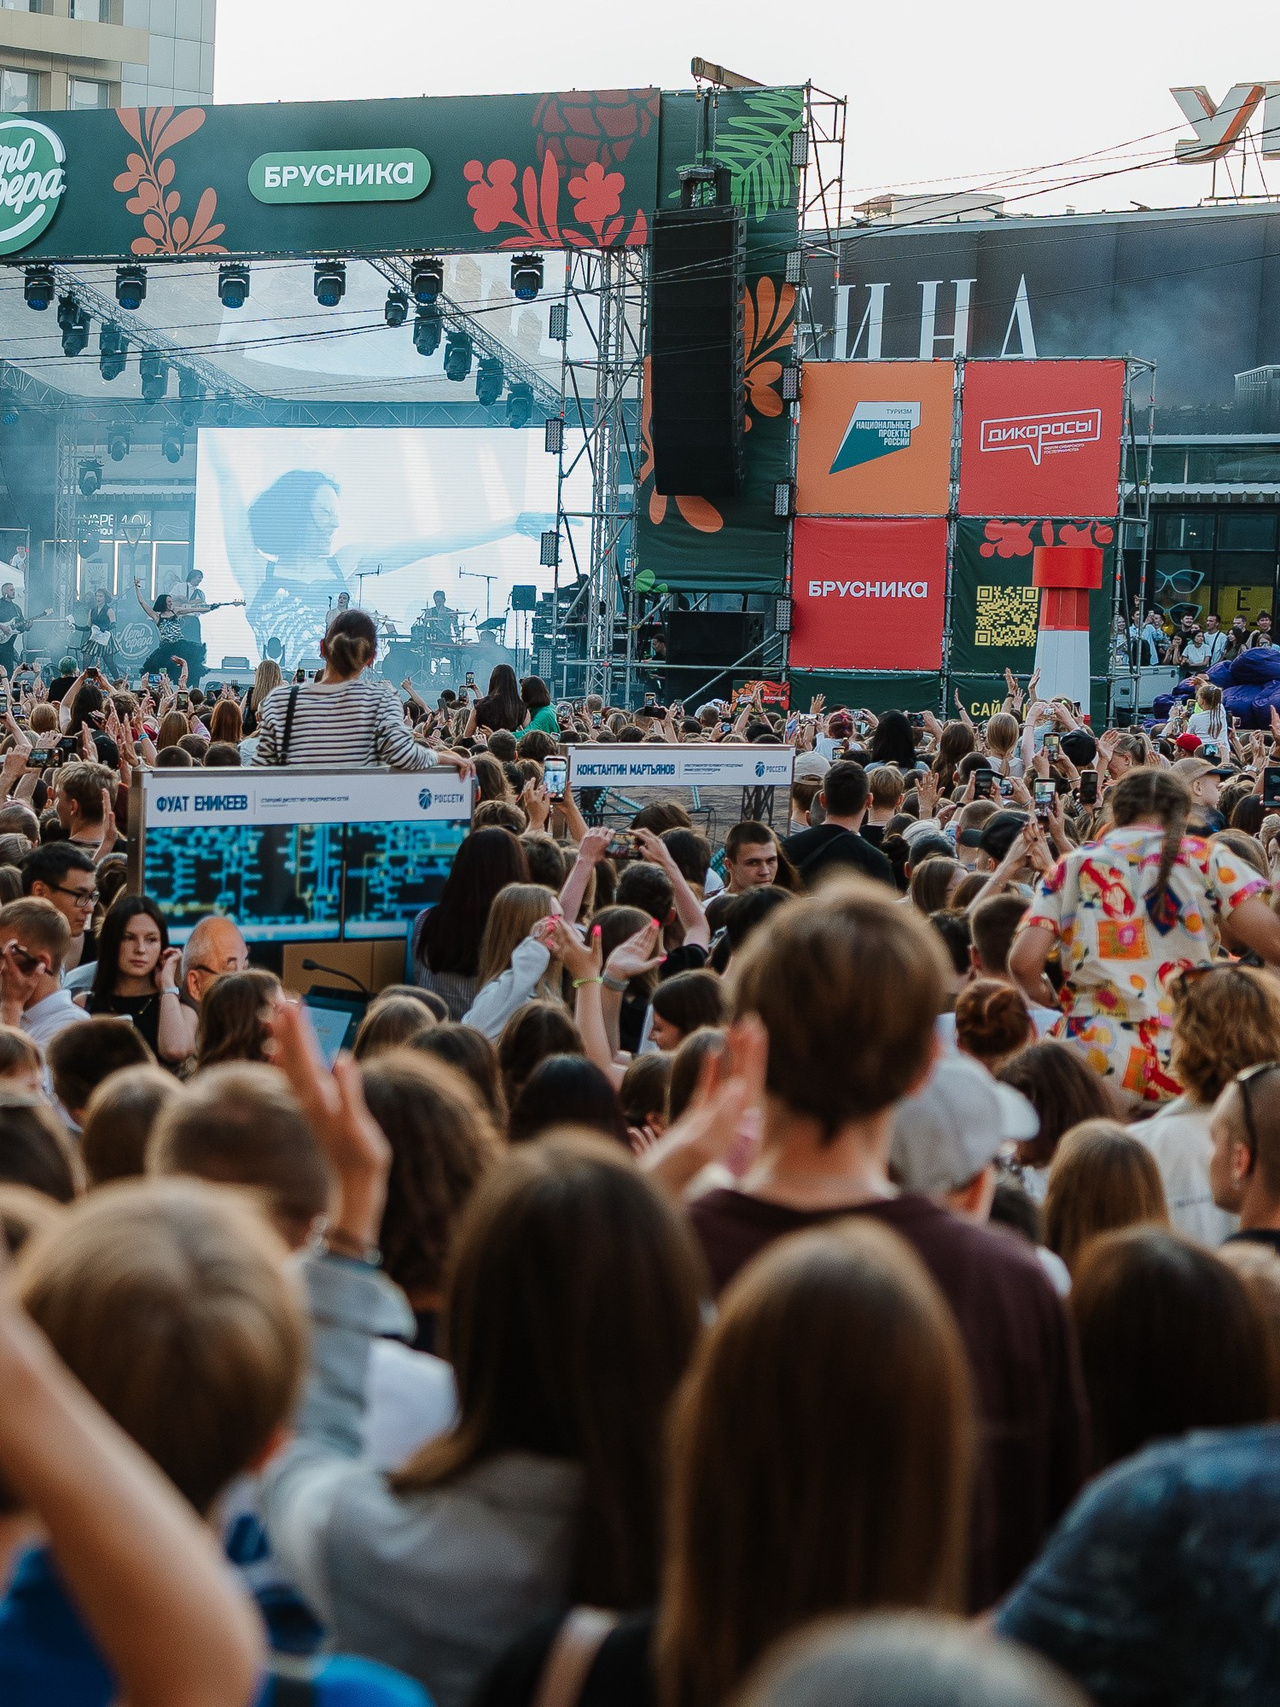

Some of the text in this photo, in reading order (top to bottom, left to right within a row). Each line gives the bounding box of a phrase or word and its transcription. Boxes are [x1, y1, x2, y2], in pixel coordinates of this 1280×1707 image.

[1168, 81, 1280, 165] У
[856, 420, 911, 431] НАЦИОНАЛЬНЫЕ
[987, 419, 1093, 442] ДИКОРОСЫ
[878, 429, 911, 438] ПРОЕКТЫ
[883, 437, 910, 446] РОССИИ
[576, 763, 676, 776] КОНСТАНТИН МАРТЬЯНОВ
[766, 765, 788, 773] РОССЕТИ
[156, 796, 190, 812] ФУАТ
[194, 795, 249, 811] ЕНИКЕЕВ
[434, 793, 465, 803] РОССЕТИ
